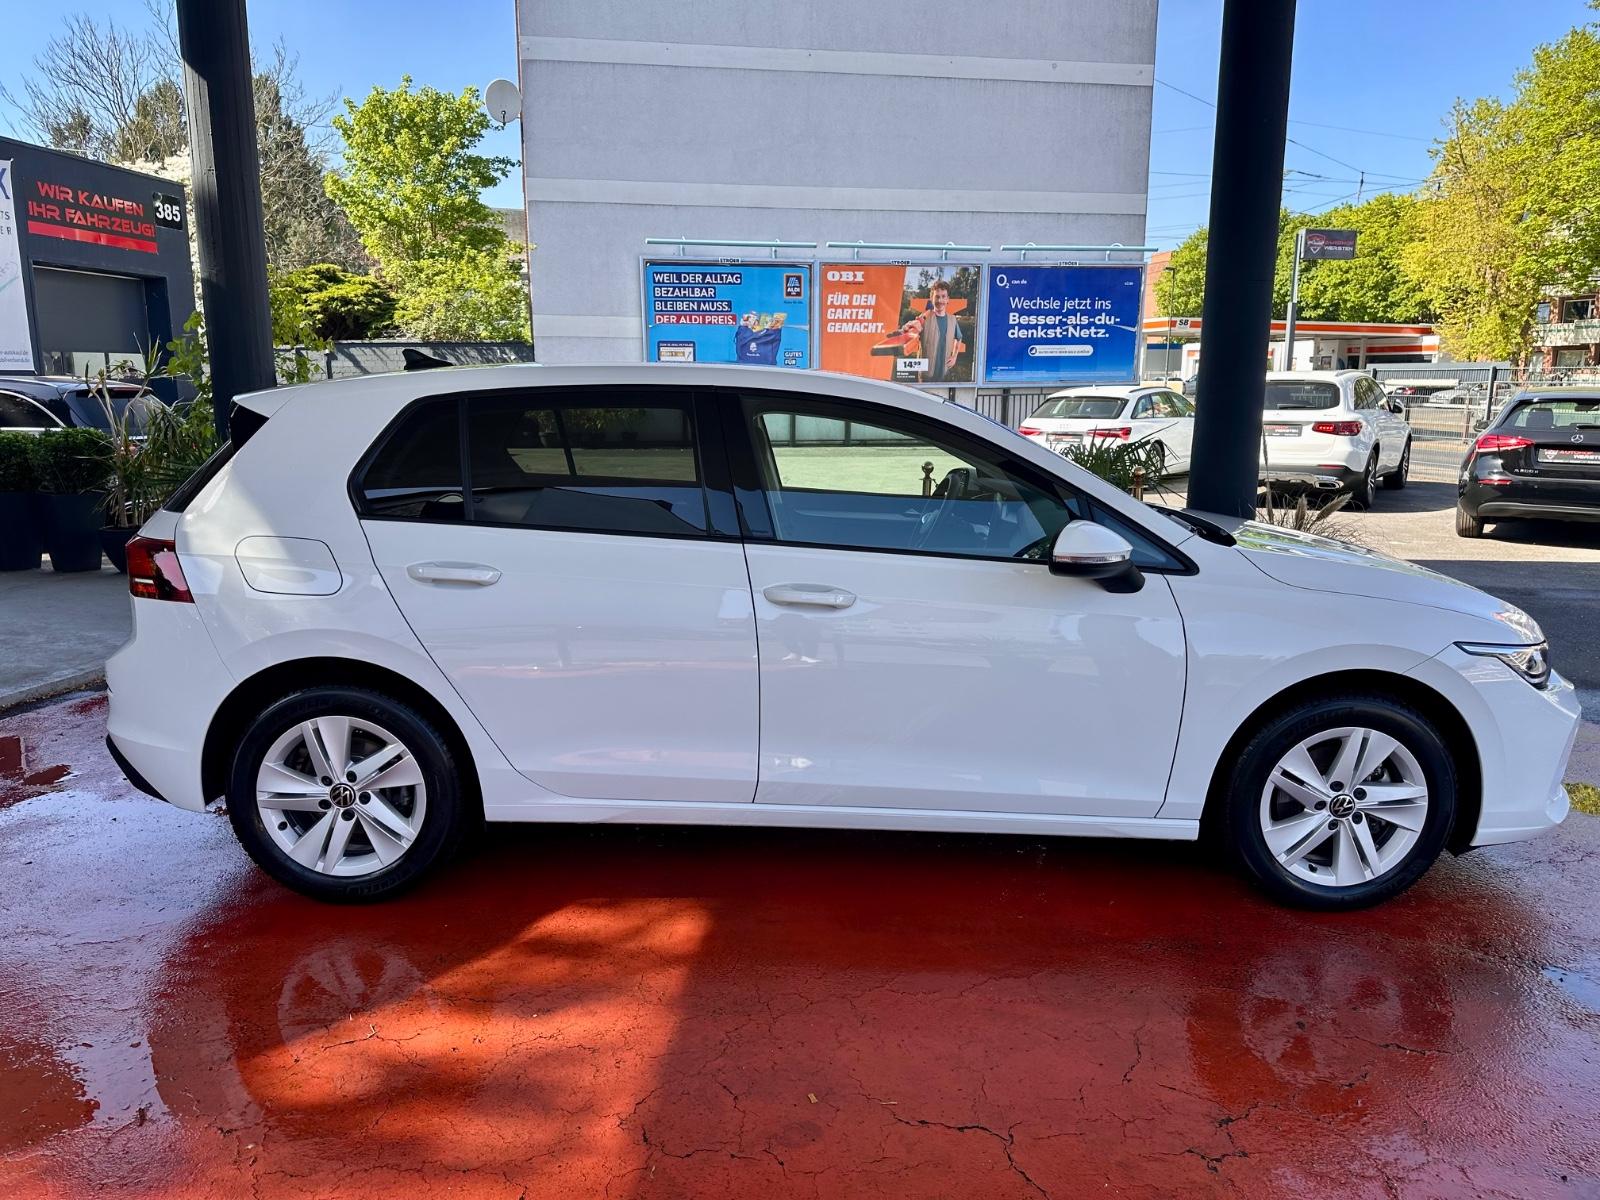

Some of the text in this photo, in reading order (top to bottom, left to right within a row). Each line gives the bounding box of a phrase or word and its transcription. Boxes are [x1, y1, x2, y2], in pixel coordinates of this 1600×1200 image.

[36, 181, 144, 217] WIR KAUFEN
[155, 202, 181, 222] 385
[28, 200, 156, 238] IHR FAHRZEUG!
[653, 273, 741, 284] WEIL DER ALLTAG
[827, 271, 865, 282] OBI
[654, 287, 716, 298] BEZAHLBAR
[827, 293, 876, 306] FÜR DEN
[1009, 296, 1112, 313] Wechsle jetzt ins
[654, 301, 731, 312] BLEIBEN MUSS.
[827, 308, 873, 320] GARTEN
[1008, 312, 1121, 326] Besser-als-du-
[655, 315, 736, 326] DER ALDI PREIS.
[827, 322, 886, 334] GEMACHT.
[1007, 326, 1110, 339] denkst-Netz.
